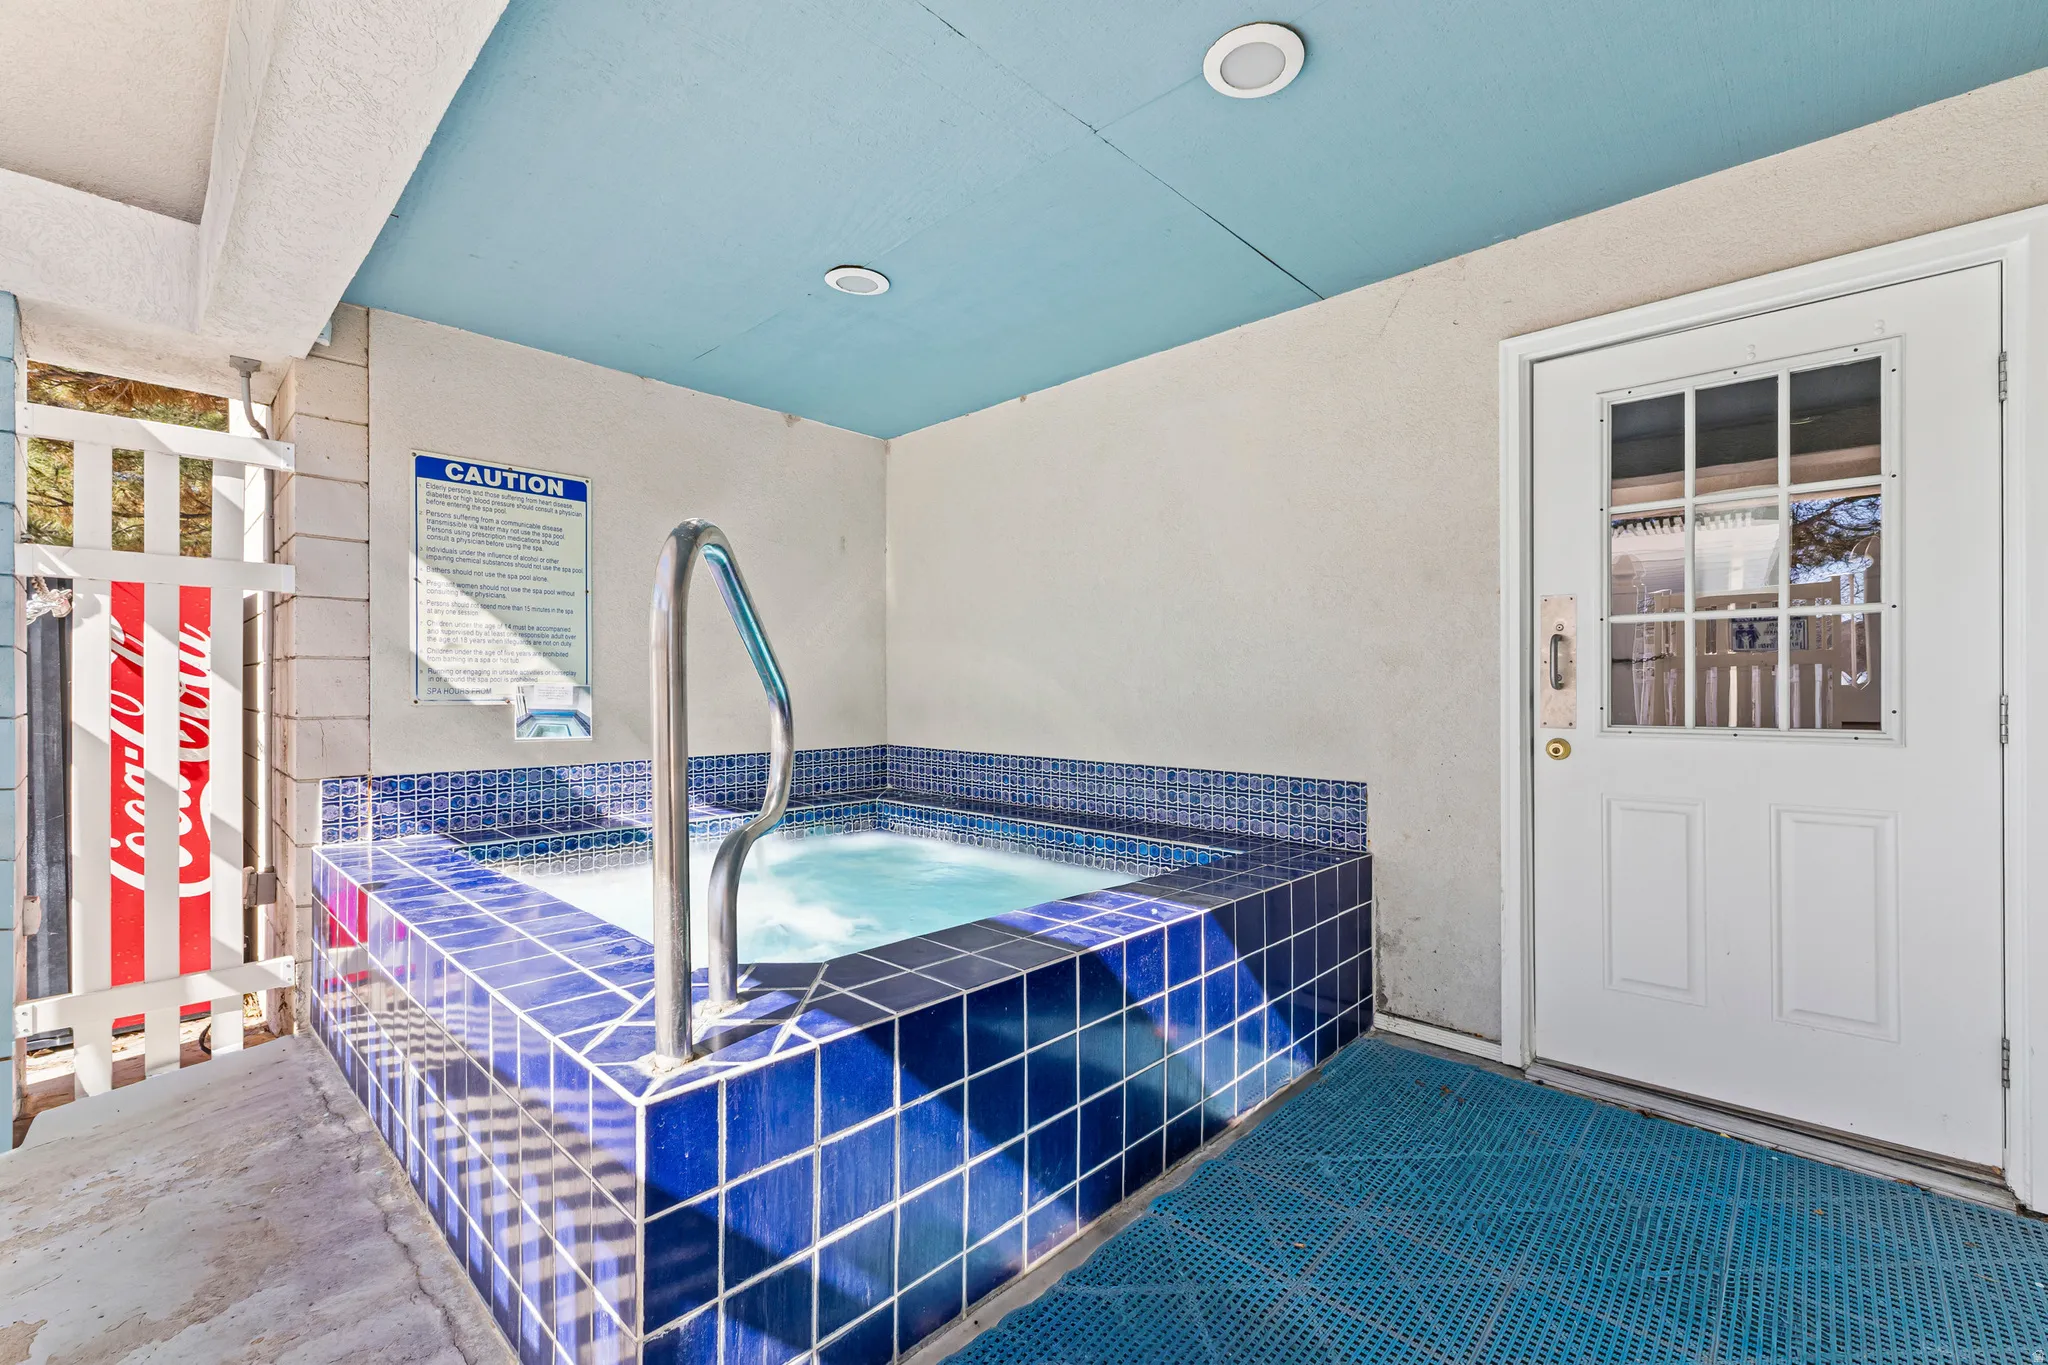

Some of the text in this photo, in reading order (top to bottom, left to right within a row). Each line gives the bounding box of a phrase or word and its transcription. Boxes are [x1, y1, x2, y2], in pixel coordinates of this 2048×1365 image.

[444, 462, 564, 497] CAUTION
[425, 481, 446, 493] Elderly
[448, 486, 471, 495] persons
[484, 490, 500, 499] those
[501, 493, 524, 504] suffering
[526, 496, 538, 504] from
[538, 498, 552, 506] heart
[425, 489, 452, 499] diabetes
[460, 494, 473, 504] high
[474, 496, 490, 505] blood
[491, 500, 515, 508] pressure
[516, 502, 534, 511] should
[559, 508, 582, 517] physician
[425, 497, 445, 506] before
[446, 501, 470, 511] entering
[482, 506, 492, 514] spa
[425, 509, 452, 519] Persons
[453, 513, 480, 524] suffering
[480, 516, 494, 524] from
[500, 520, 541, 530] communicable
[542, 523, 562, 532] disease
[426, 517, 468, 528] transmissible
[496, 527, 509, 535] may
[426, 524, 559, 546] Persons using prescription medications should
[457, 536, 485, 545] physician
[486, 539, 504, 547] before
[505, 542, 521, 551] using
[426, 544, 457, 554] Individuals
[459, 548, 476, 556] under
[487, 551, 512, 560] influence
[520, 554, 539, 562] alcohol
[456, 555, 482, 564] chemical
[482, 558, 514, 567] substances
[514, 561, 532, 569] should
[452, 568, 472, 576] should
[479, 583, 499, 591] should
[544, 588, 555, 596] pool
[426, 598, 450, 606] Persons
[480, 602, 496, 610] spend
[434, 608, 445, 616] any
[543, 650, 569, 658] prohibited
[490, 676, 502, 684] pool
